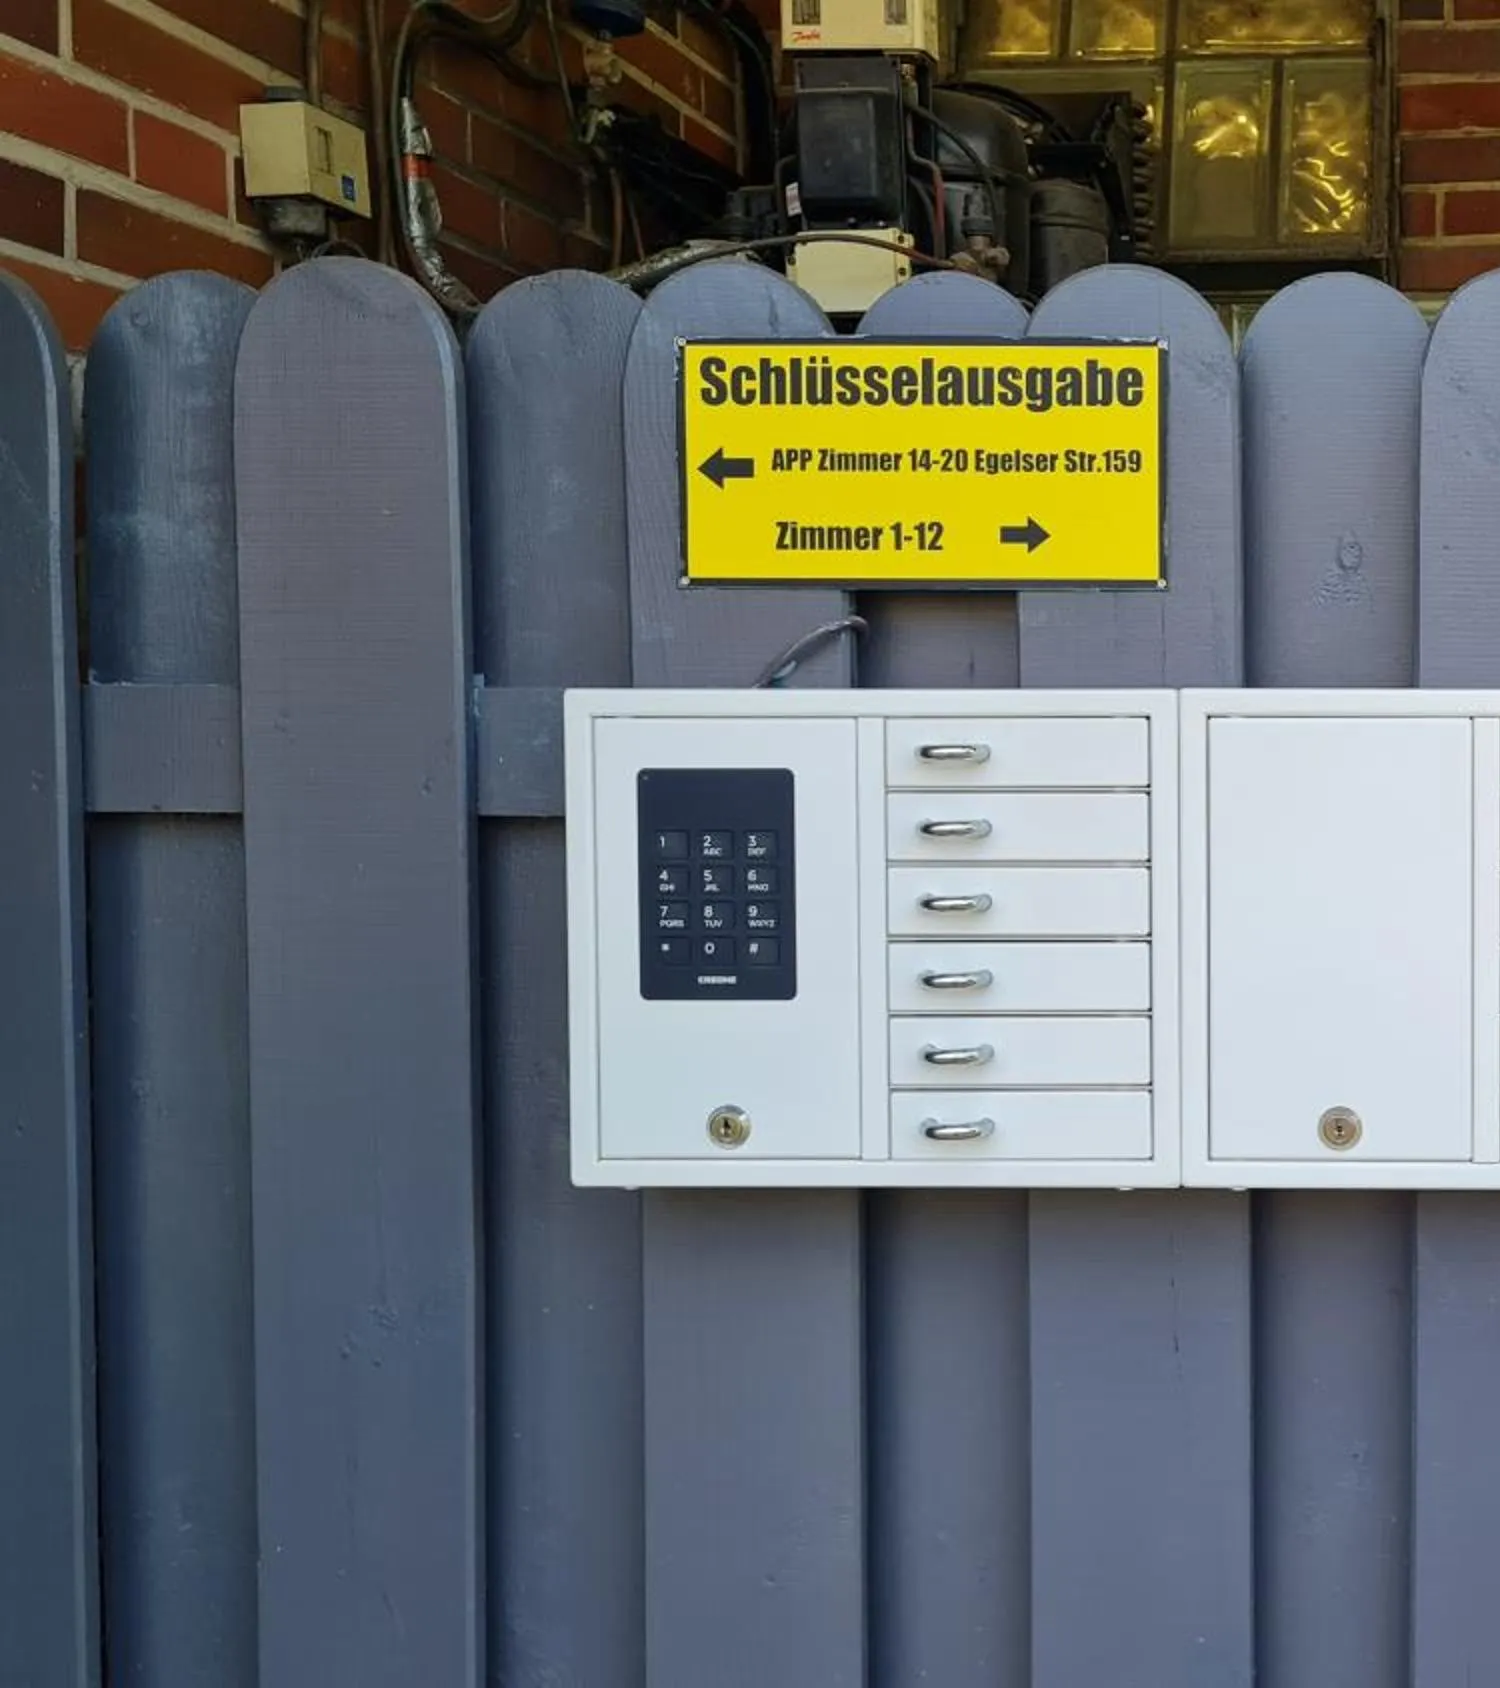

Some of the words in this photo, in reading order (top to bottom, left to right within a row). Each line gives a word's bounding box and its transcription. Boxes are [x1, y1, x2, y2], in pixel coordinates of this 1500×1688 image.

[699, 355, 1144, 413] Schlüsselausgabe
[771, 448, 813, 472] APP
[817, 448, 903, 472] Zimmer
[907, 448, 969, 473] 14-20
[974, 449, 1059, 475] Egelser
[1064, 449, 1142, 473] Str.159
[775, 521, 884, 551] Zimmer
[889, 521, 944, 551] 1-12
[703, 835, 712, 847] 2
[748, 835, 757, 847] 3
[659, 869, 669, 881] 4
[703, 869, 713, 882] 5
[747, 869, 757, 882] 6
[659, 905, 669, 918] 7
[703, 905, 714, 918] 8
[748, 905, 758, 918] 9
